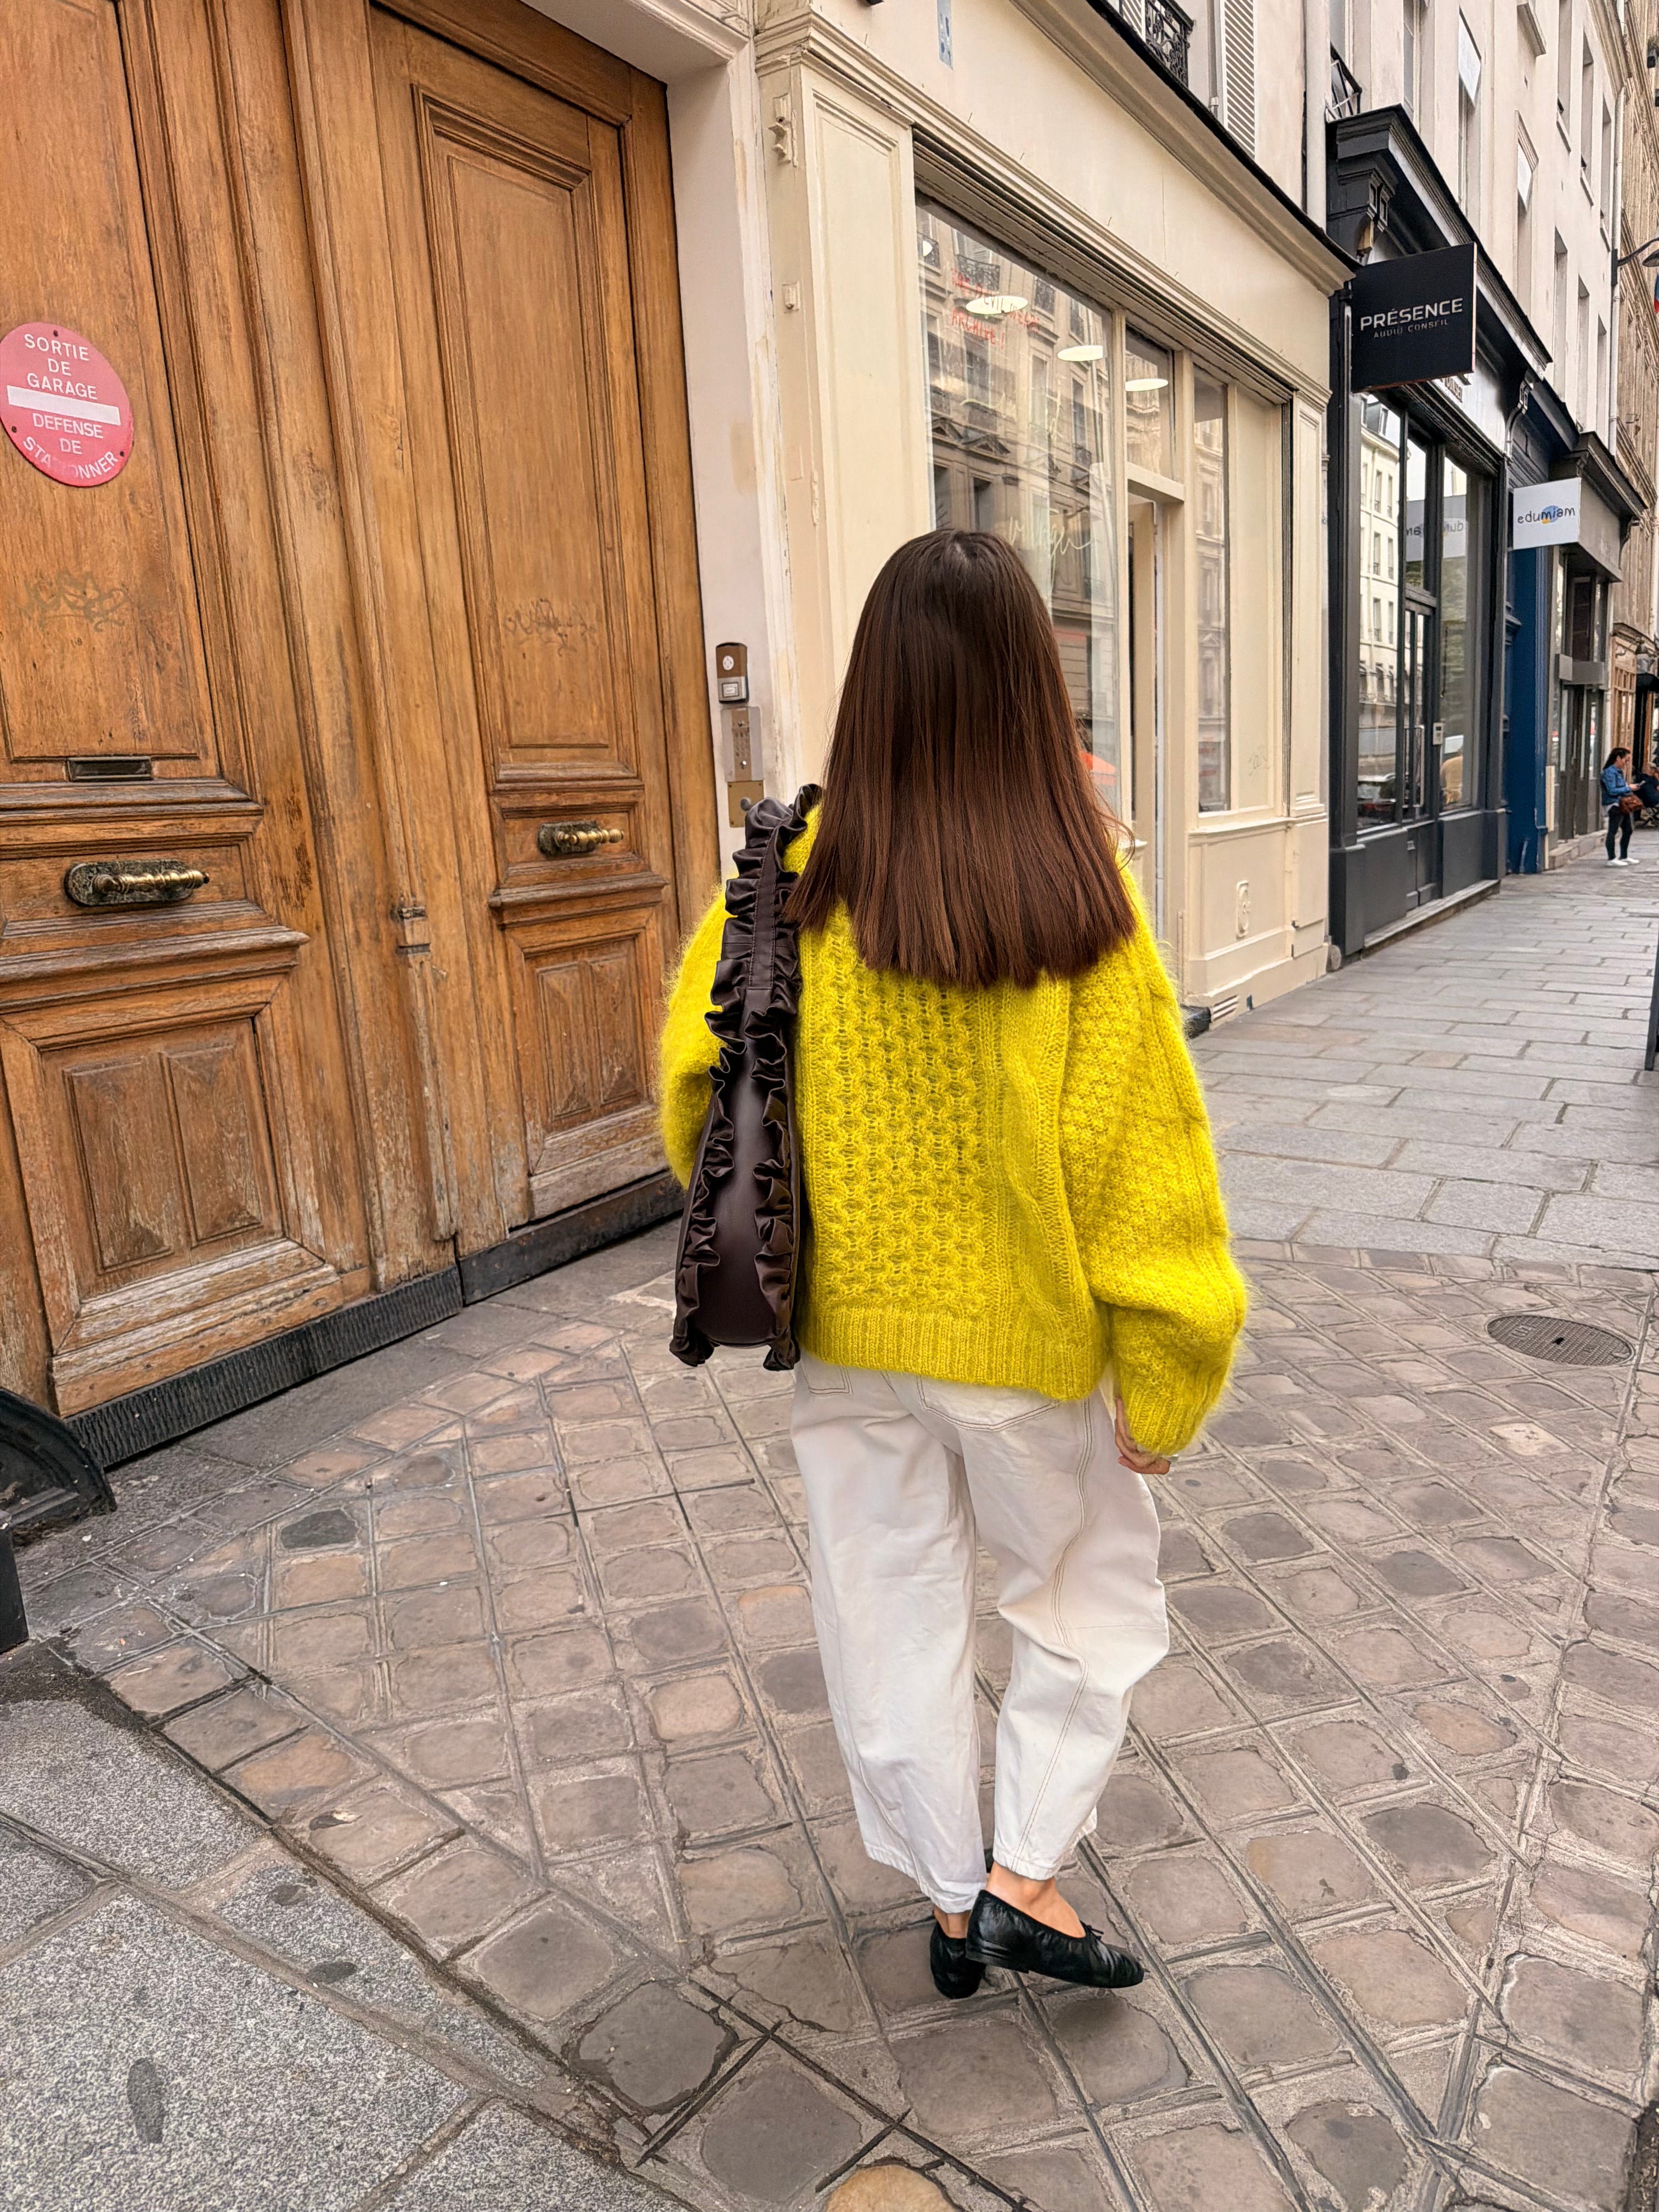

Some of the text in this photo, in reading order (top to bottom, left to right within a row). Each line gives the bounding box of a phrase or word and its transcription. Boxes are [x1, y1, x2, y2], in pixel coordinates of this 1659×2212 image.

[1360, 297, 1463, 331] PRÉSENCE
[1374, 326, 1403, 338] AUDIO
[24, 334, 89, 361] SORTIE
[48, 358, 71, 376] DE
[27, 373, 98, 400] GARAGE
[33, 413, 103, 439] DEFENSE
[23, 436, 119, 479] STAONNER
[60, 438, 82, 455] DE
[1517, 507, 1576, 524] edumiam
